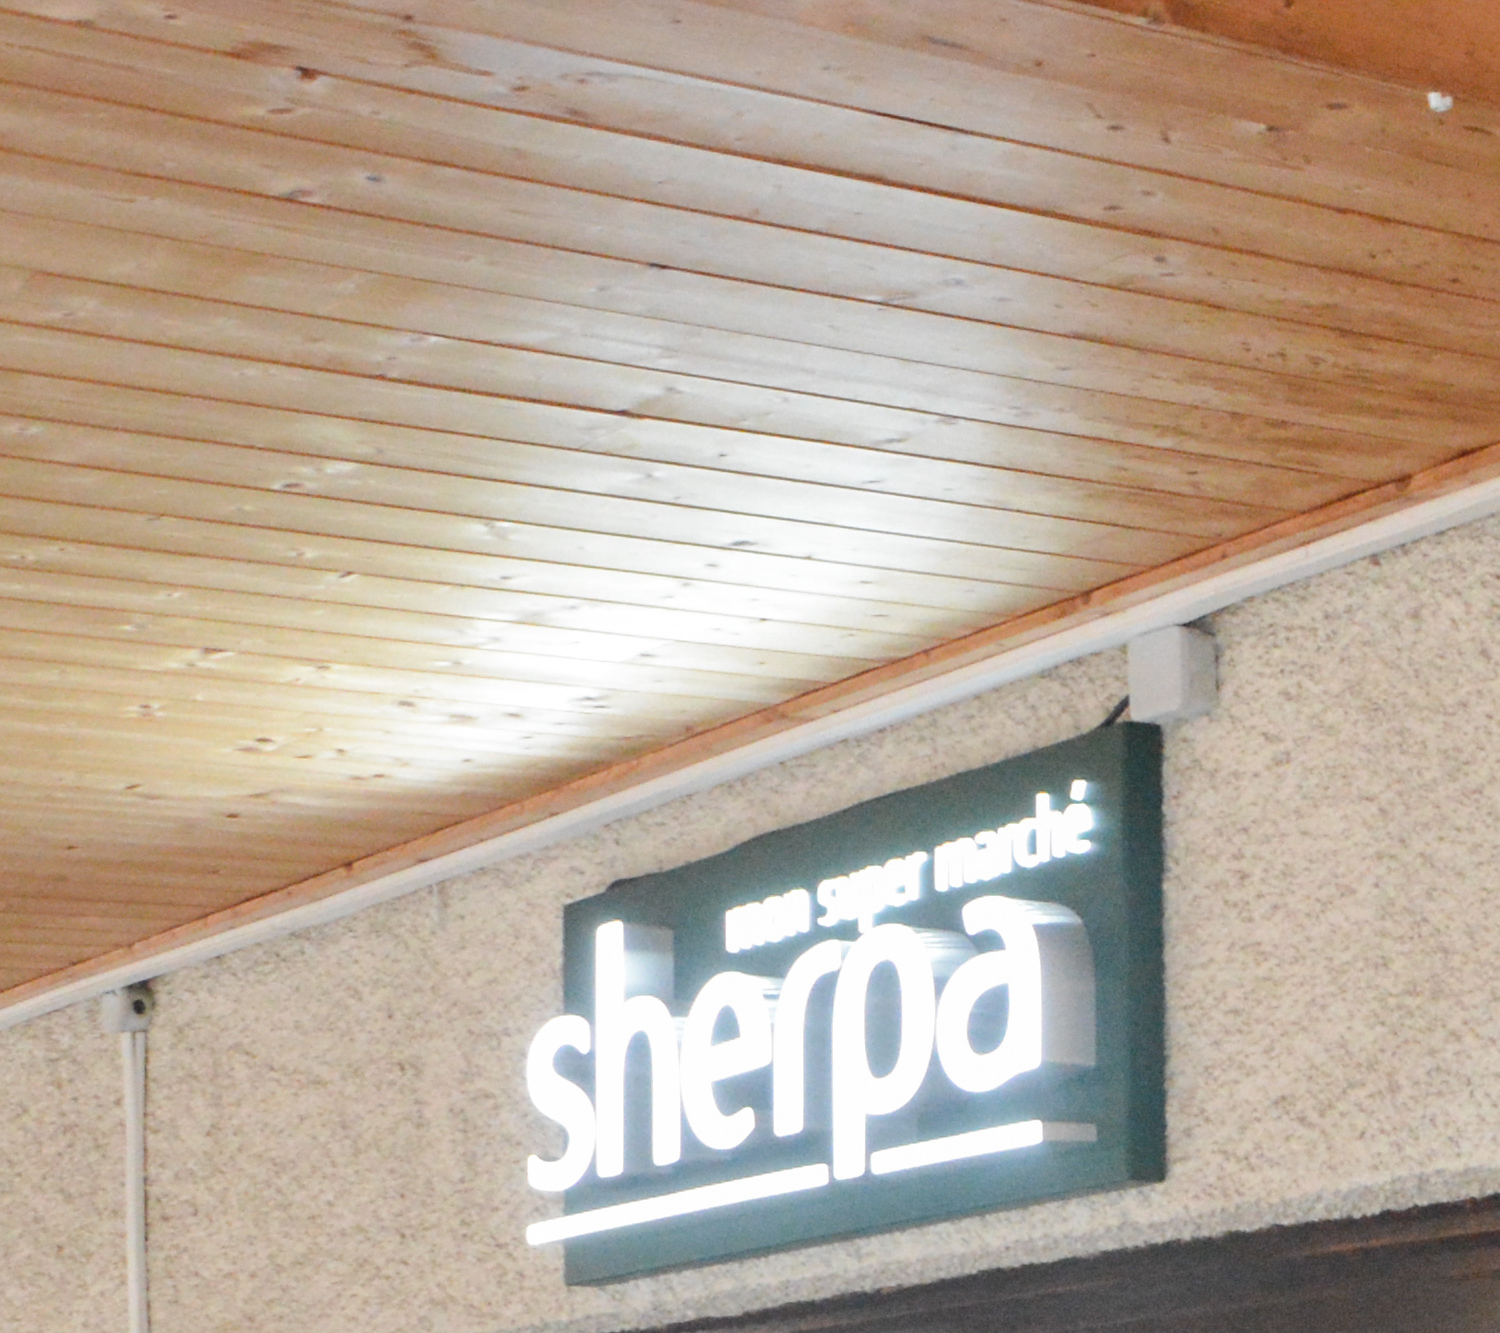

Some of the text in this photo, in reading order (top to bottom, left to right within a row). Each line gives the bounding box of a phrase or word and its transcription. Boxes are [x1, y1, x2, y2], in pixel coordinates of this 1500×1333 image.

[725, 780, 1093, 953] mon super marché
[526, 895, 1042, 1192] sherpa
